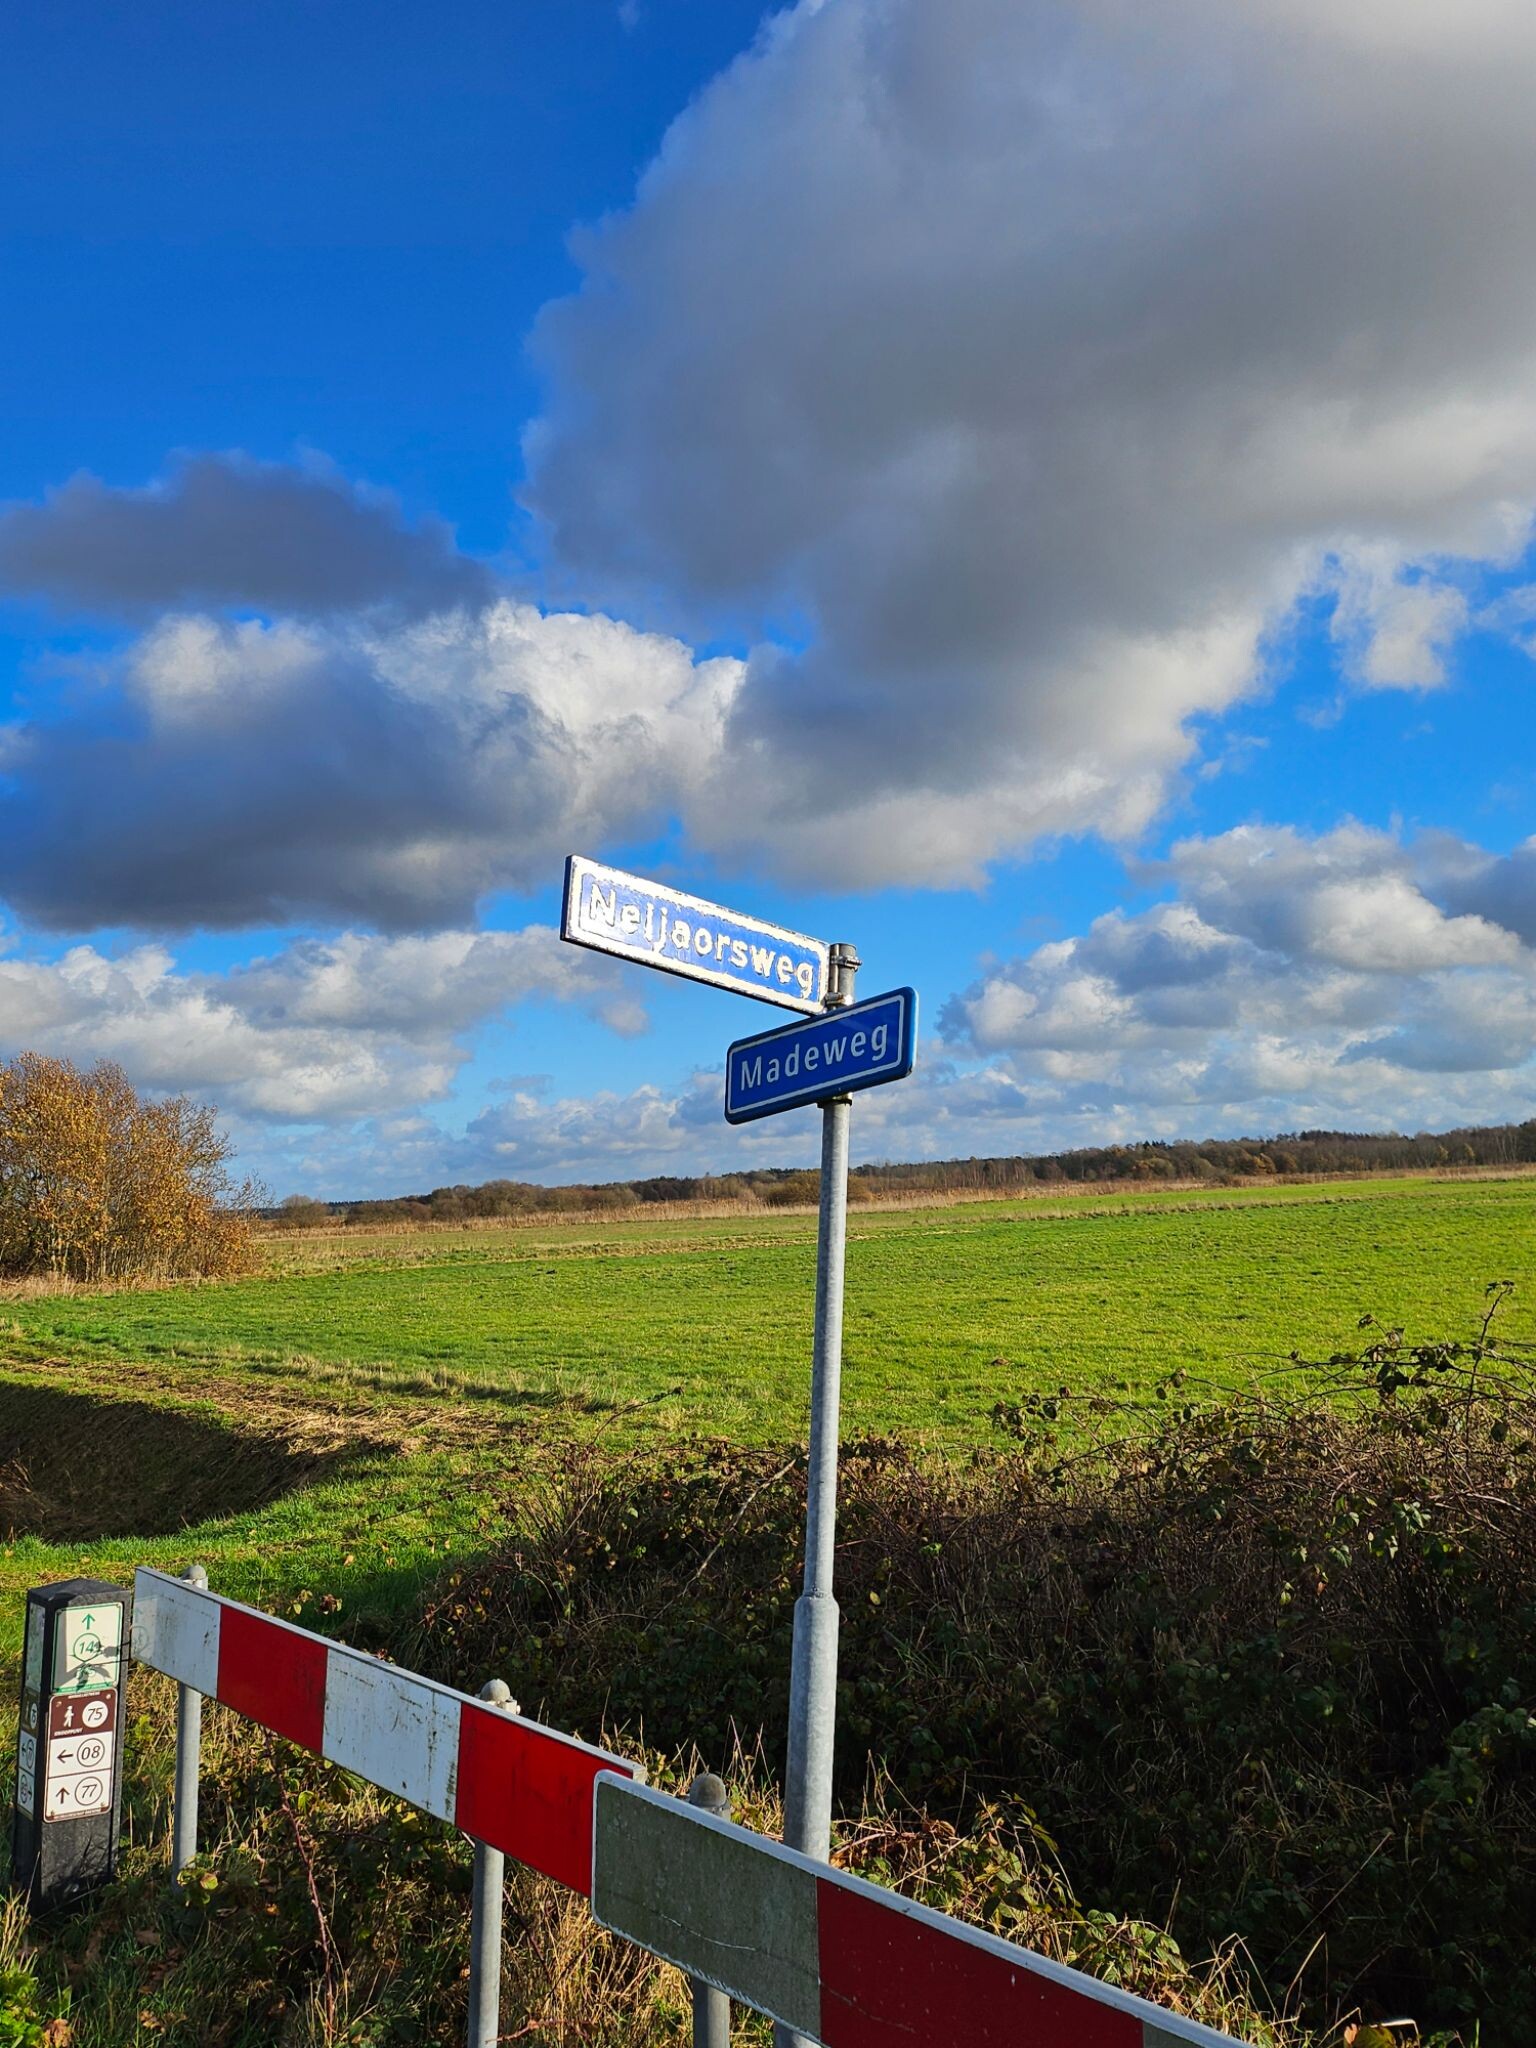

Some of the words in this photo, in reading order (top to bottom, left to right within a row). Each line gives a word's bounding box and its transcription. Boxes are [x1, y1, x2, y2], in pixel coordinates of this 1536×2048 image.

[740, 1023, 888, 1091] Madeweg
[80, 1641, 96, 1654] 14
[87, 1707, 104, 1722] 75
[81, 1745, 101, 1760] 08
[81, 1783, 97, 1799] 77
